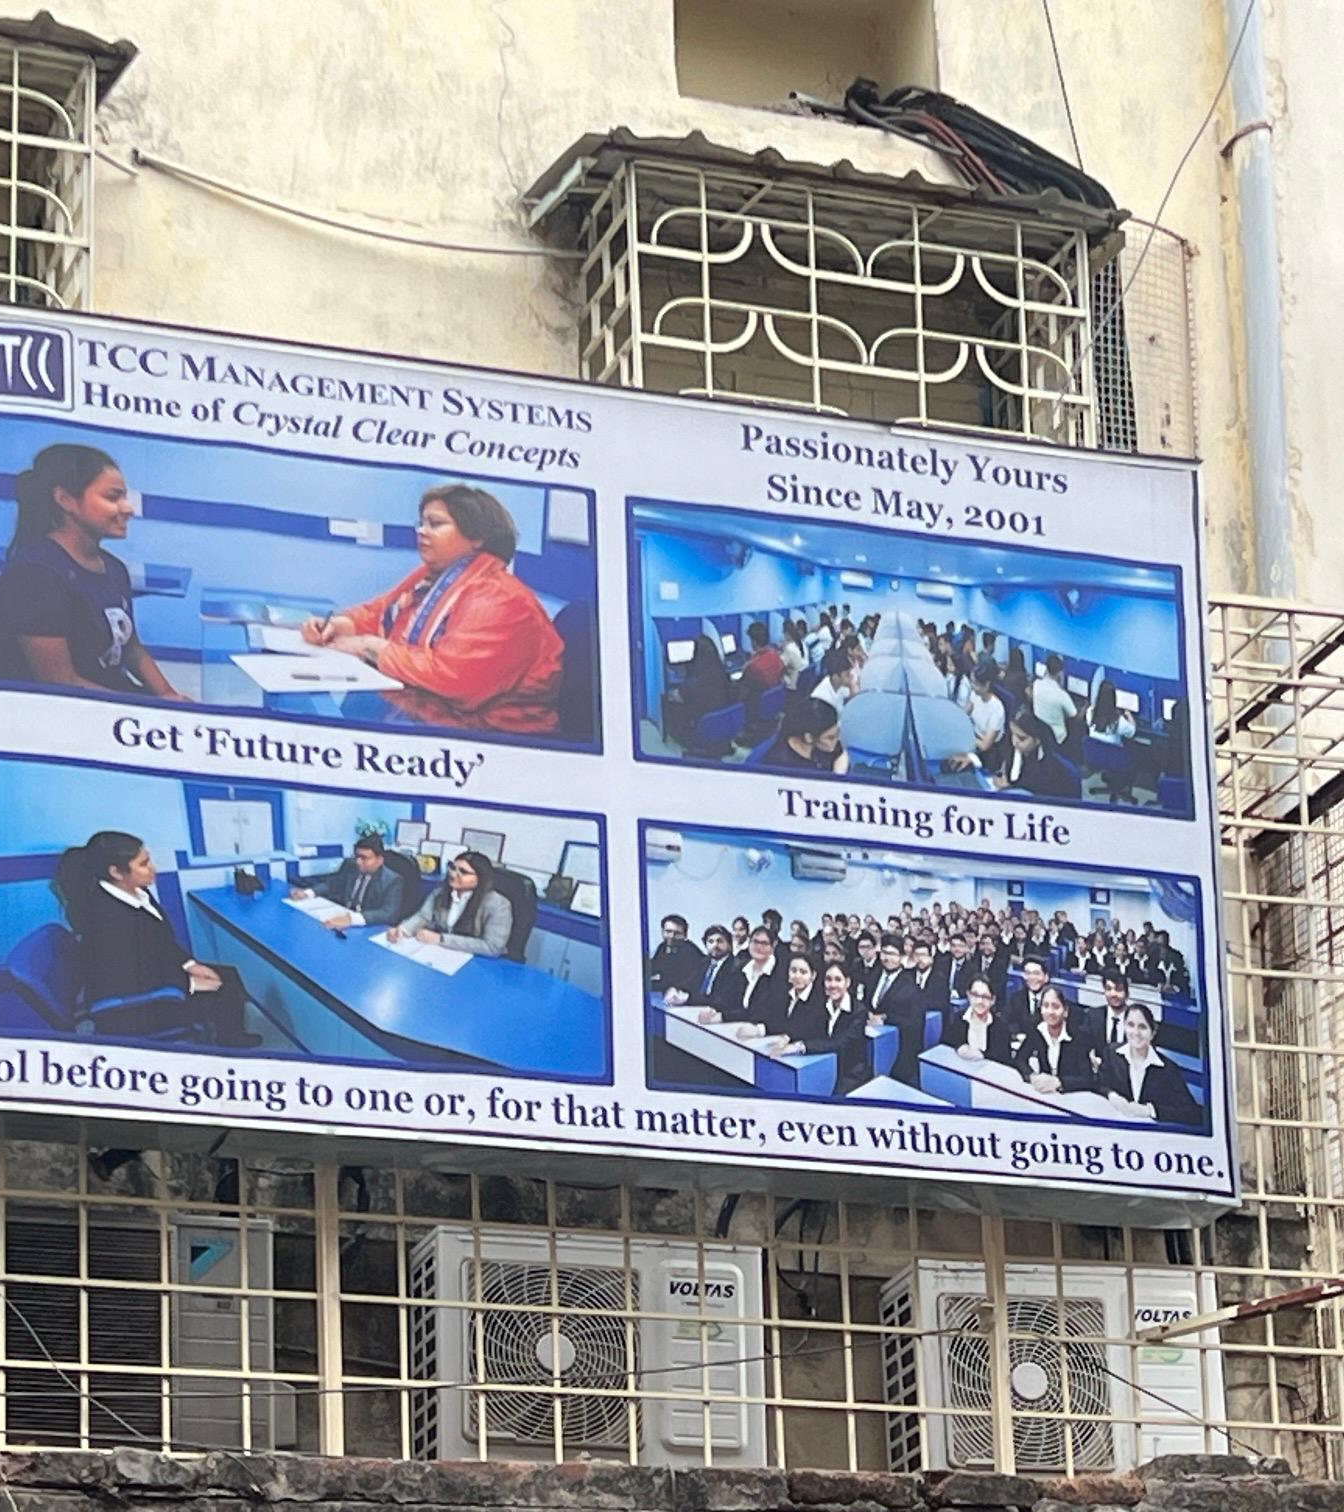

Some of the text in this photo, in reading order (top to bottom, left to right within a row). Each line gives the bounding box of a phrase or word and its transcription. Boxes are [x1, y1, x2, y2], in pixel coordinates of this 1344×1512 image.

[80, 338, 168, 379] TCC
[81, 382, 580, 471] Home of Crystal Clear Concepts
[741, 423, 1069, 495] Passionately Yours
[766, 474, 1047, 537] Since May, 2001
[113, 715, 182, 754] Get
[778, 788, 1071, 846] Training for Life
[40, 1051, 169, 1097] before
[180, 1067, 287, 1112] going
[296, 1077, 333, 1112] to
[345, 1087, 414, 1116] one
[423, 1090, 475, 1126] or,
[487, 1085, 543, 1124] for
[551, 1093, 624, 1131] that
[634, 1103, 767, 1148] matter,
[777, 1117, 857, 1148] even
[867, 1119, 1003, 1161] without
[1009, 1133, 1104, 1178] going
[1111, 1139, 1143, 1174] to
[1153, 1146, 1226, 1181] one.
